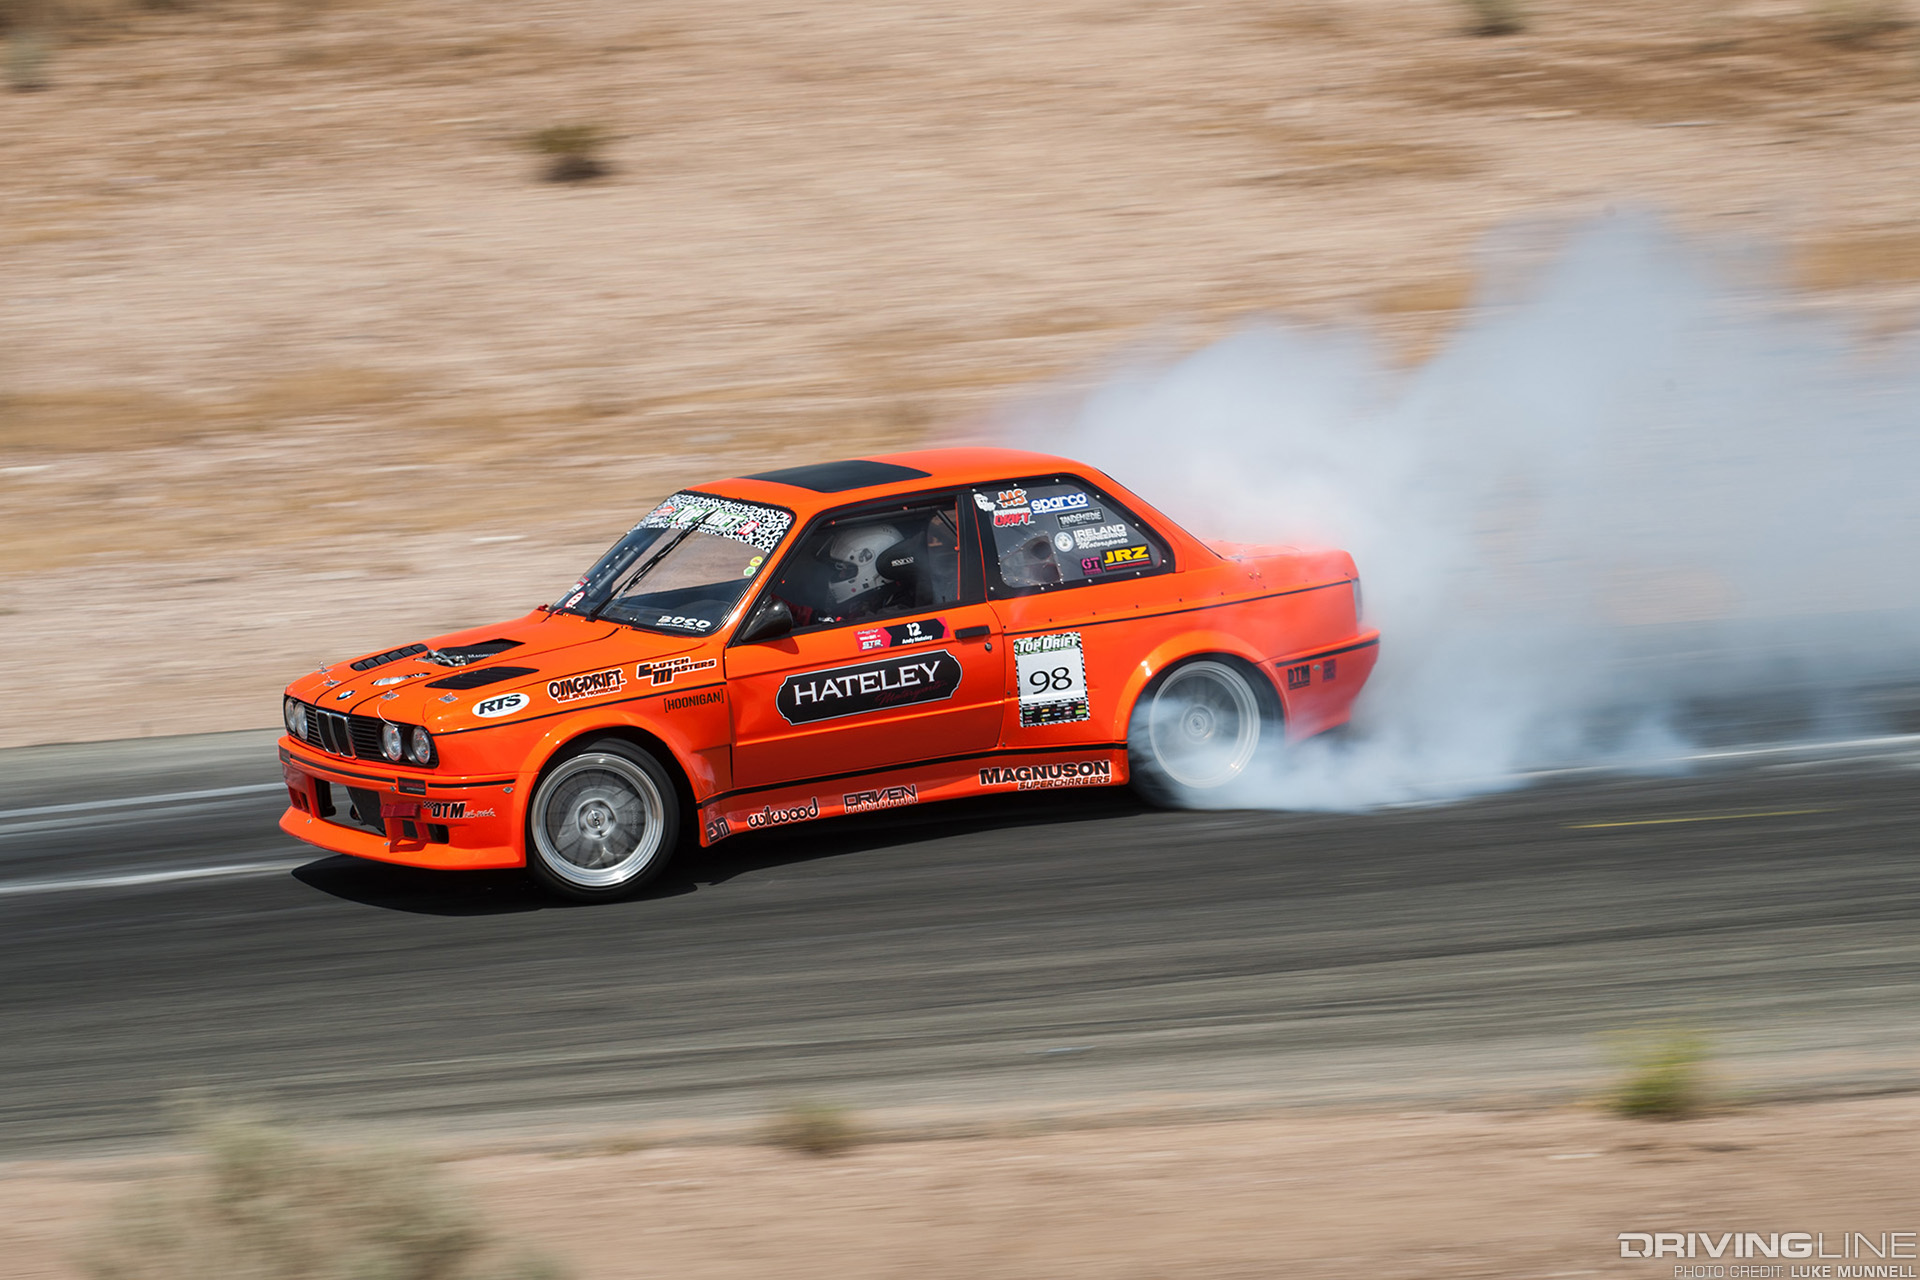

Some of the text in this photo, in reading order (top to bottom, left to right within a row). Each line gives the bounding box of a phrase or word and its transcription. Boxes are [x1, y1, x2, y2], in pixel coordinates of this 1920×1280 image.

[1031, 493, 1087, 512] sparco
[995, 512, 1031, 526] DRIFT
[1073, 524, 1126, 538] IRELAND
[1104, 546, 1149, 564] JRZ
[906, 622, 922, 637] 12
[902, 637, 915, 645] Andy
[1018, 636, 1077, 653] TOP DRIFT
[793, 660, 941, 706] HATELEY
[1029, 666, 1073, 695] 98
[478, 693, 521, 715] RTS
[979, 760, 1111, 785] MAGNUSON
[1018, 775, 1110, 790] SUPERCHARGERS
[844, 784, 916, 807] DRIVEN
[431, 802, 466, 819] DTM
[748, 797, 819, 829] wilwood
